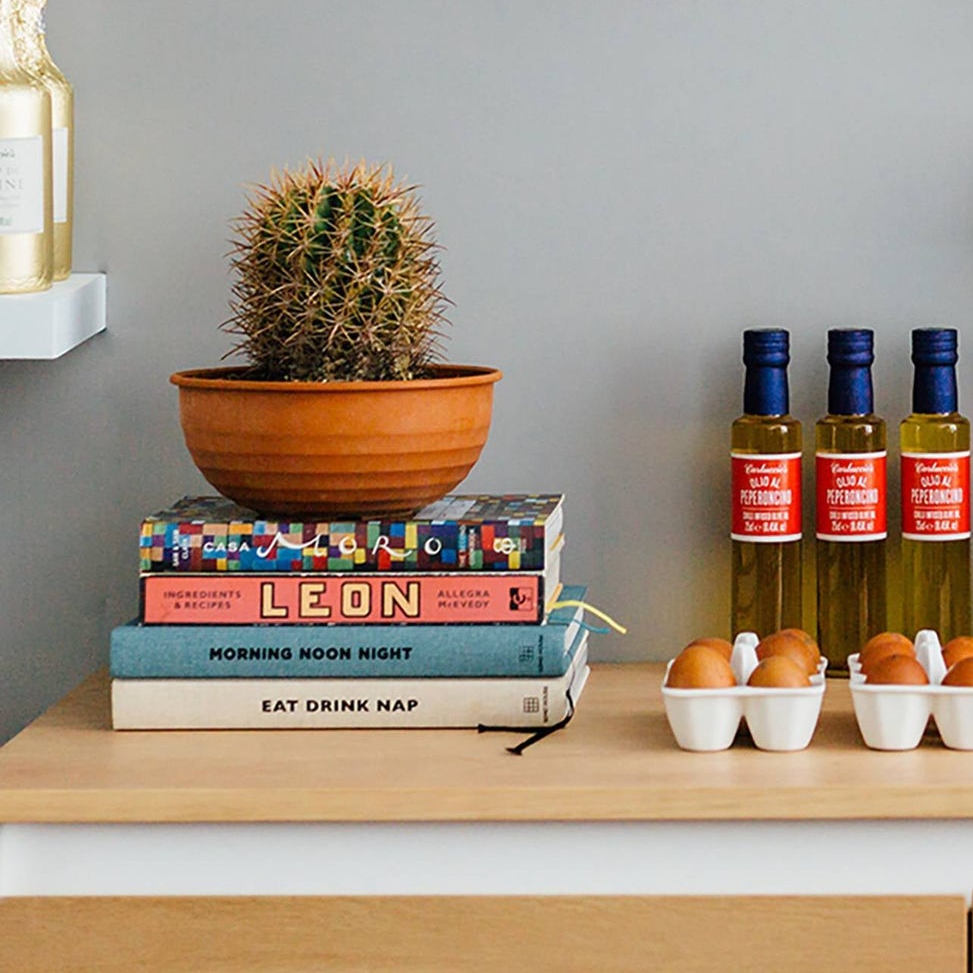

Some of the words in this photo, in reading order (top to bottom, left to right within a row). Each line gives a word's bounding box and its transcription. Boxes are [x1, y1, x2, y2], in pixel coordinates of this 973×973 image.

[203, 542, 250, 553] CASA
[256, 531, 442, 558] MORO
[163, 590, 242, 599] INGREDIENTS
[437, 590, 490, 598] ALLEGRA
[174, 601, 181, 610] &
[184, 601, 231, 610] RECIPES
[259, 581, 422, 619] LEON
[438, 600, 490, 609] McEVEDY
[209, 647, 293, 661] MORNING
[299, 647, 354, 661] NOON
[358, 647, 413, 661] NIGHT
[262, 699, 299, 713] EAT
[306, 699, 369, 713] DRINK
[377, 699, 419, 713] NAP
